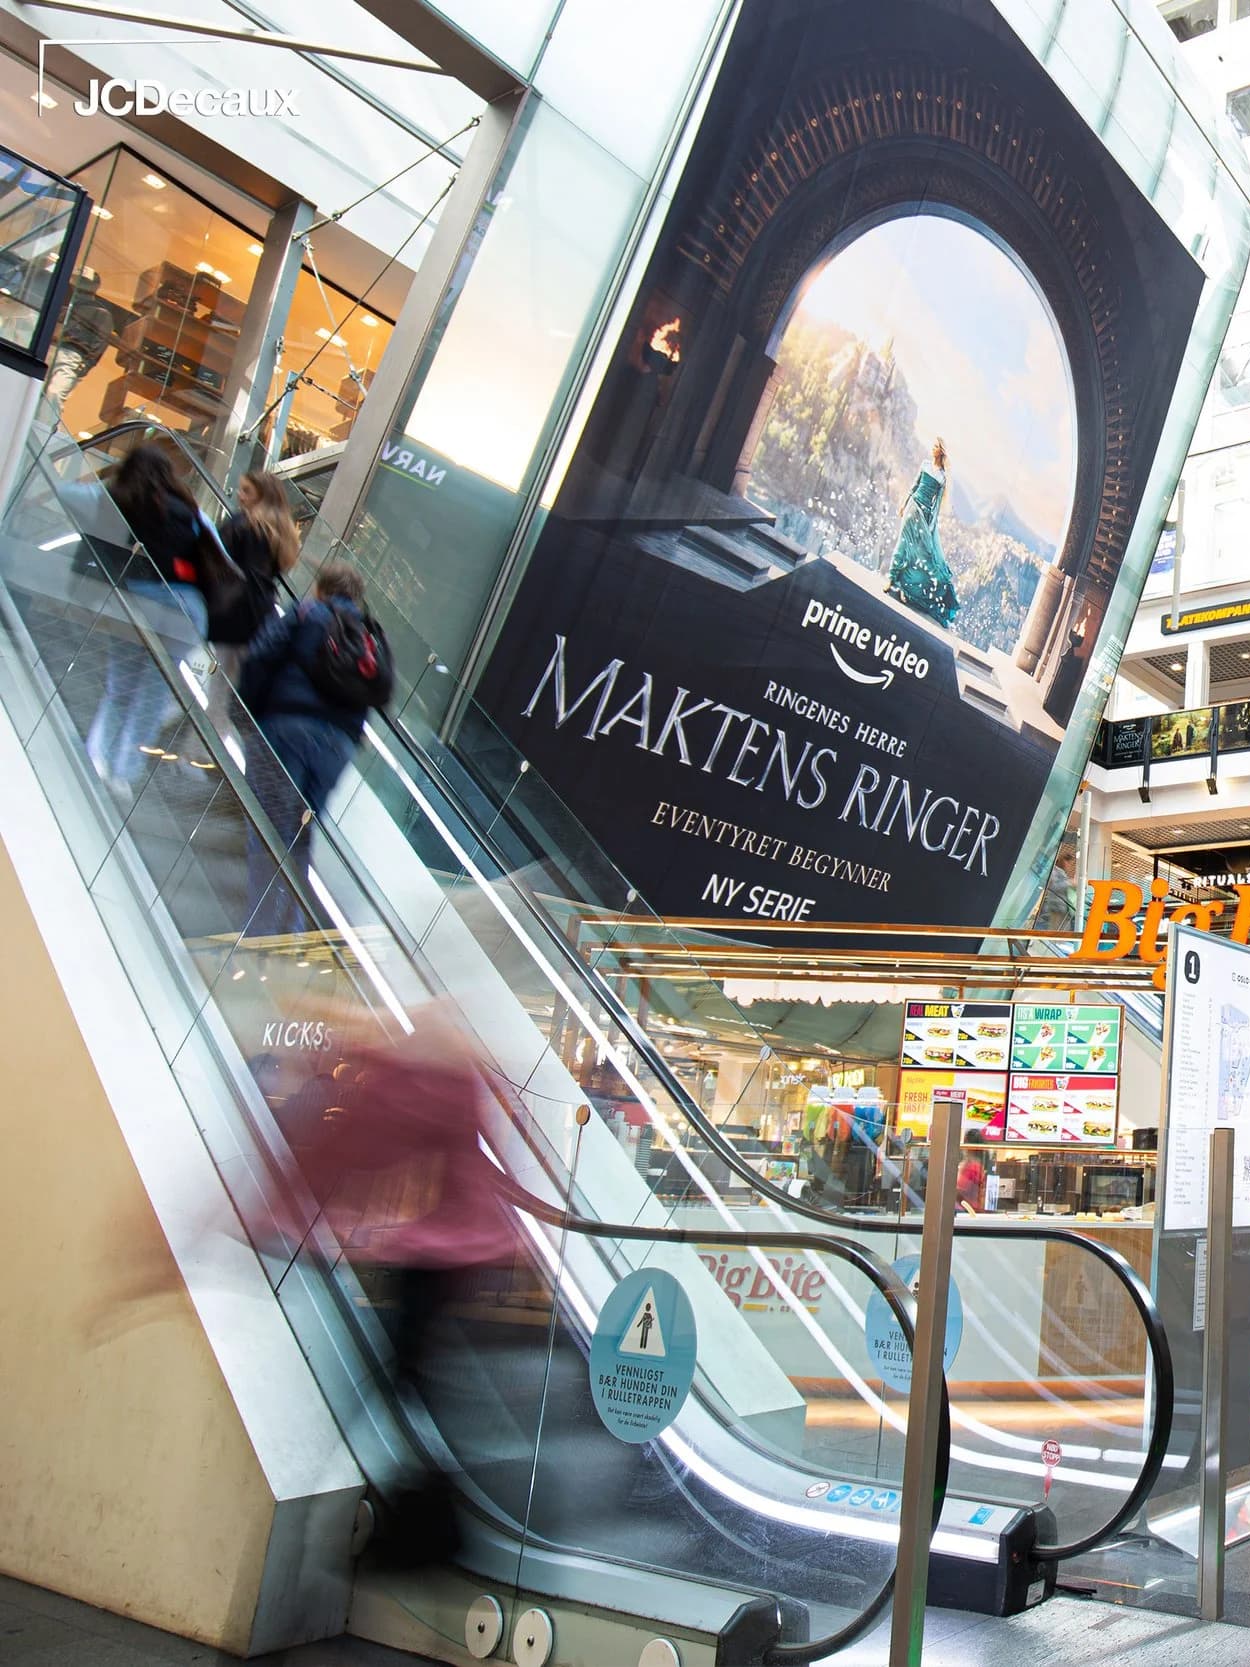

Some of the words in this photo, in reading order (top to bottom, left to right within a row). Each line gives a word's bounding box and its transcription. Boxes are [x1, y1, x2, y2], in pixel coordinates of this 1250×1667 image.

[801, 599, 870, 650] prime
[872, 632, 930, 680] video
[763, 680, 850, 735] RINGENES
[854, 722, 908, 758] HERRE
[521, 634, 838, 810] MAKTENS
[837, 764, 1001, 879] RINGER
[651, 802, 786, 861] EVENTYRET
[787, 846, 892, 893] BEGYNNER
[701, 874, 745, 908] NY
[743, 885, 816, 922] SERIE
[924, 1004, 950, 1017] MEAT
[1034, 1008, 1062, 1021] WRAP
[262, 1021, 324, 1047] KICKS
[904, 1091, 928, 1102] FRESH
[745, 1256, 826, 1302] Bite
[874, 1339, 891, 1349] BÆR
[616, 1363, 665, 1382] VENNLIGST
[599, 1374, 618, 1387] BÆR
[620, 1378, 658, 1394] HUNDEN
[661, 1385, 678, 1398] DIN
[607, 1388, 671, 1411] RULLETRAPPEN
